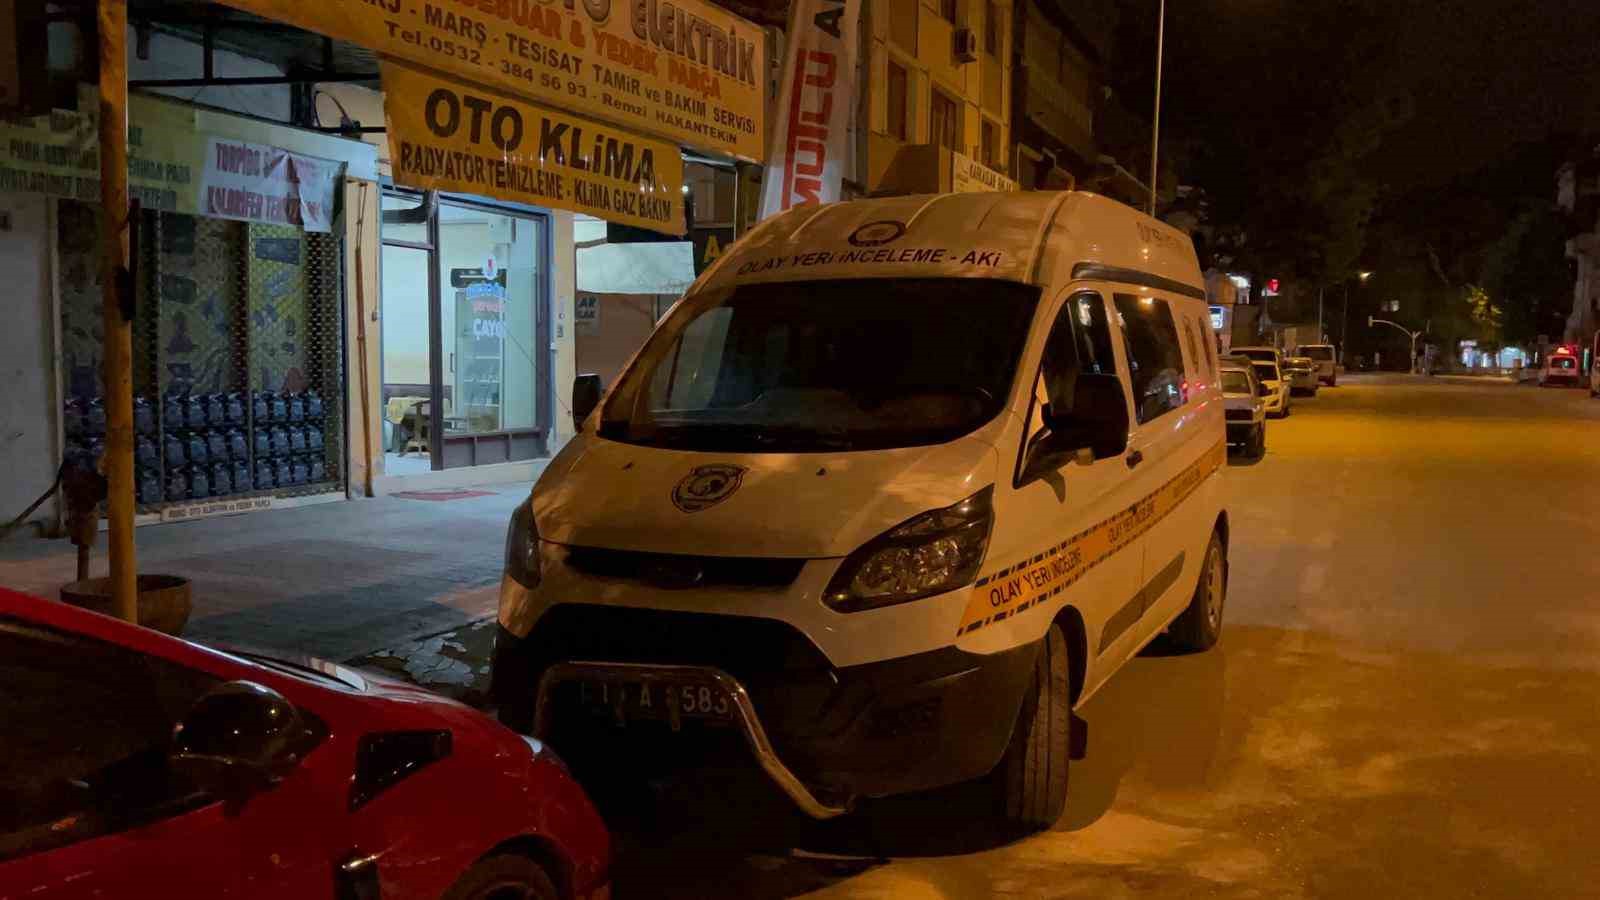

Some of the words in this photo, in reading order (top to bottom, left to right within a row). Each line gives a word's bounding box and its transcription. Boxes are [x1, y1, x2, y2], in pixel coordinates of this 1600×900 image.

[424, 4, 487, 48] MARŞ
[645, 87, 661, 102] ve
[664, 89, 707, 119] BAKIM
[500, 59, 533, 83] 384
[541, 73, 561, 91] 56
[567, 80, 587, 99] 93
[601, 92, 647, 118] Remzi
[425, 88, 524, 152] OTO
[613, 187, 637, 215] GAZ
[638, 196, 672, 223] BAKIM
[737, 256, 785, 275] OLAY
[990, 577, 1023, 607] OLAY
